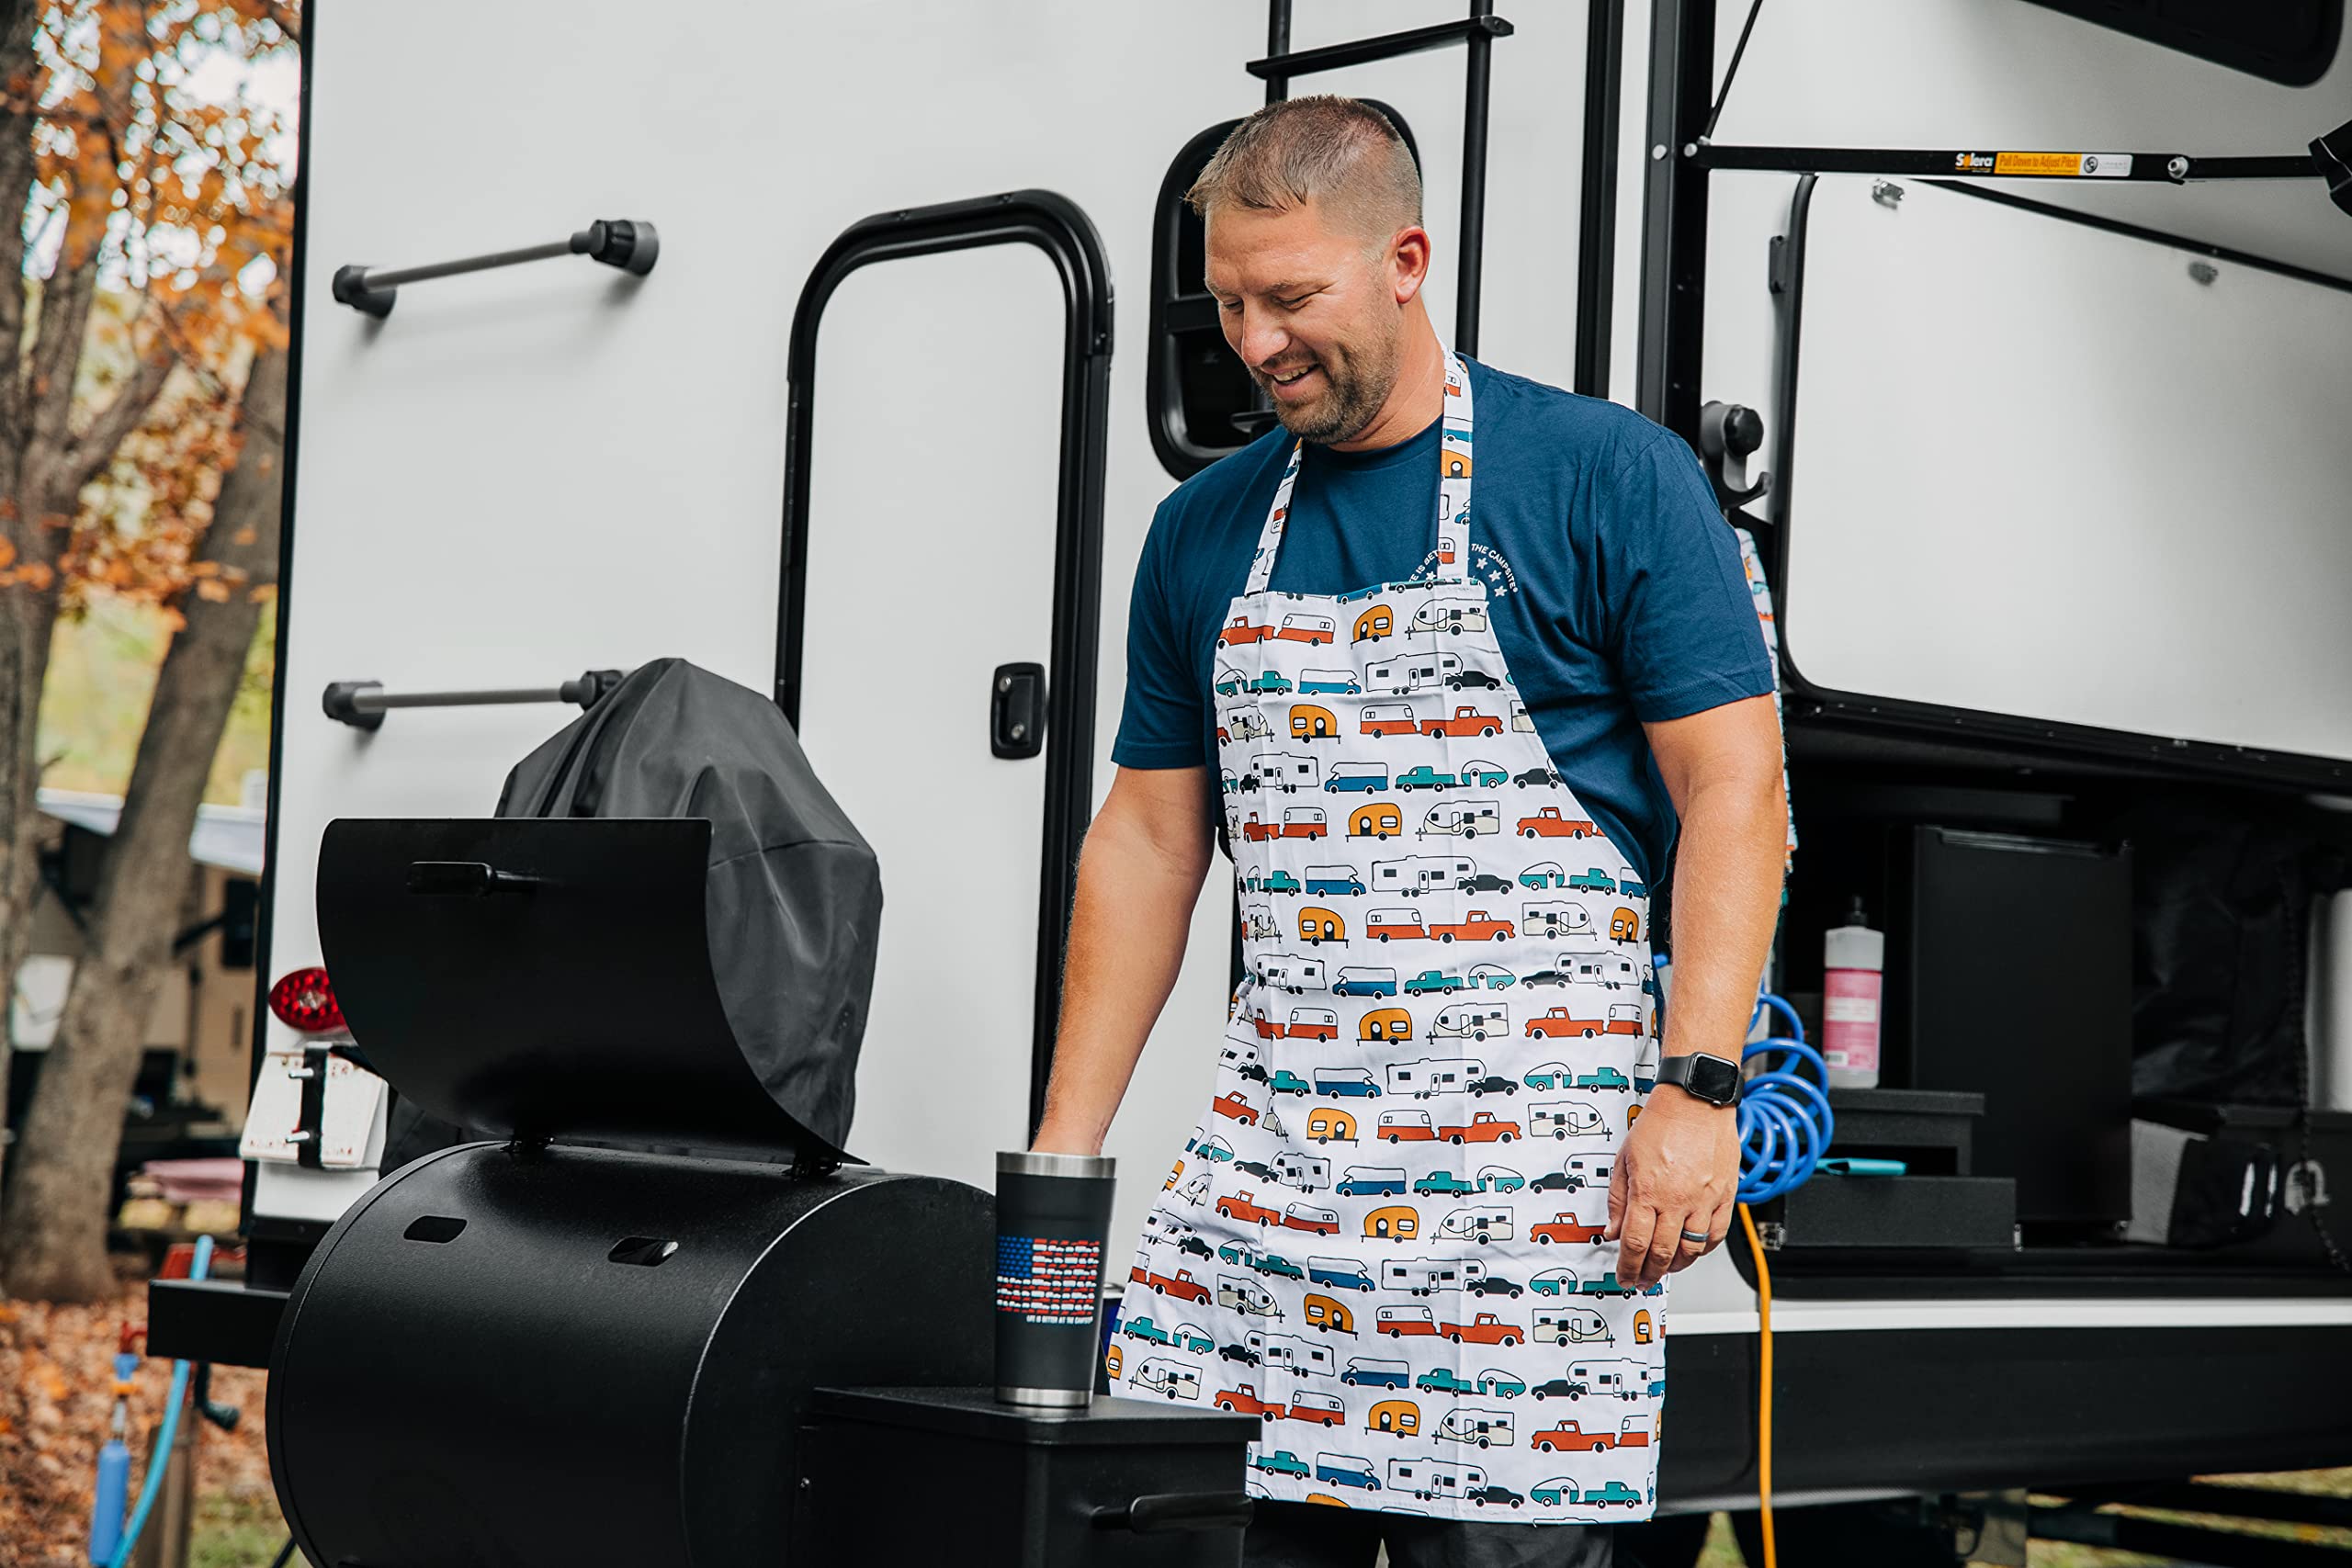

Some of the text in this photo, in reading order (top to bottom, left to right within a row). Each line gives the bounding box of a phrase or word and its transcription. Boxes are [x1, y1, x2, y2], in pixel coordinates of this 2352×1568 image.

[1955, 152, 1994, 167] Solera
[1999, 154, 2078, 169] Pull Down to Adjust Pitch
[1415, 565, 1426, 574] IS
[1424, 549, 1439, 566] BET
[1471, 543, 1489, 554] THE
